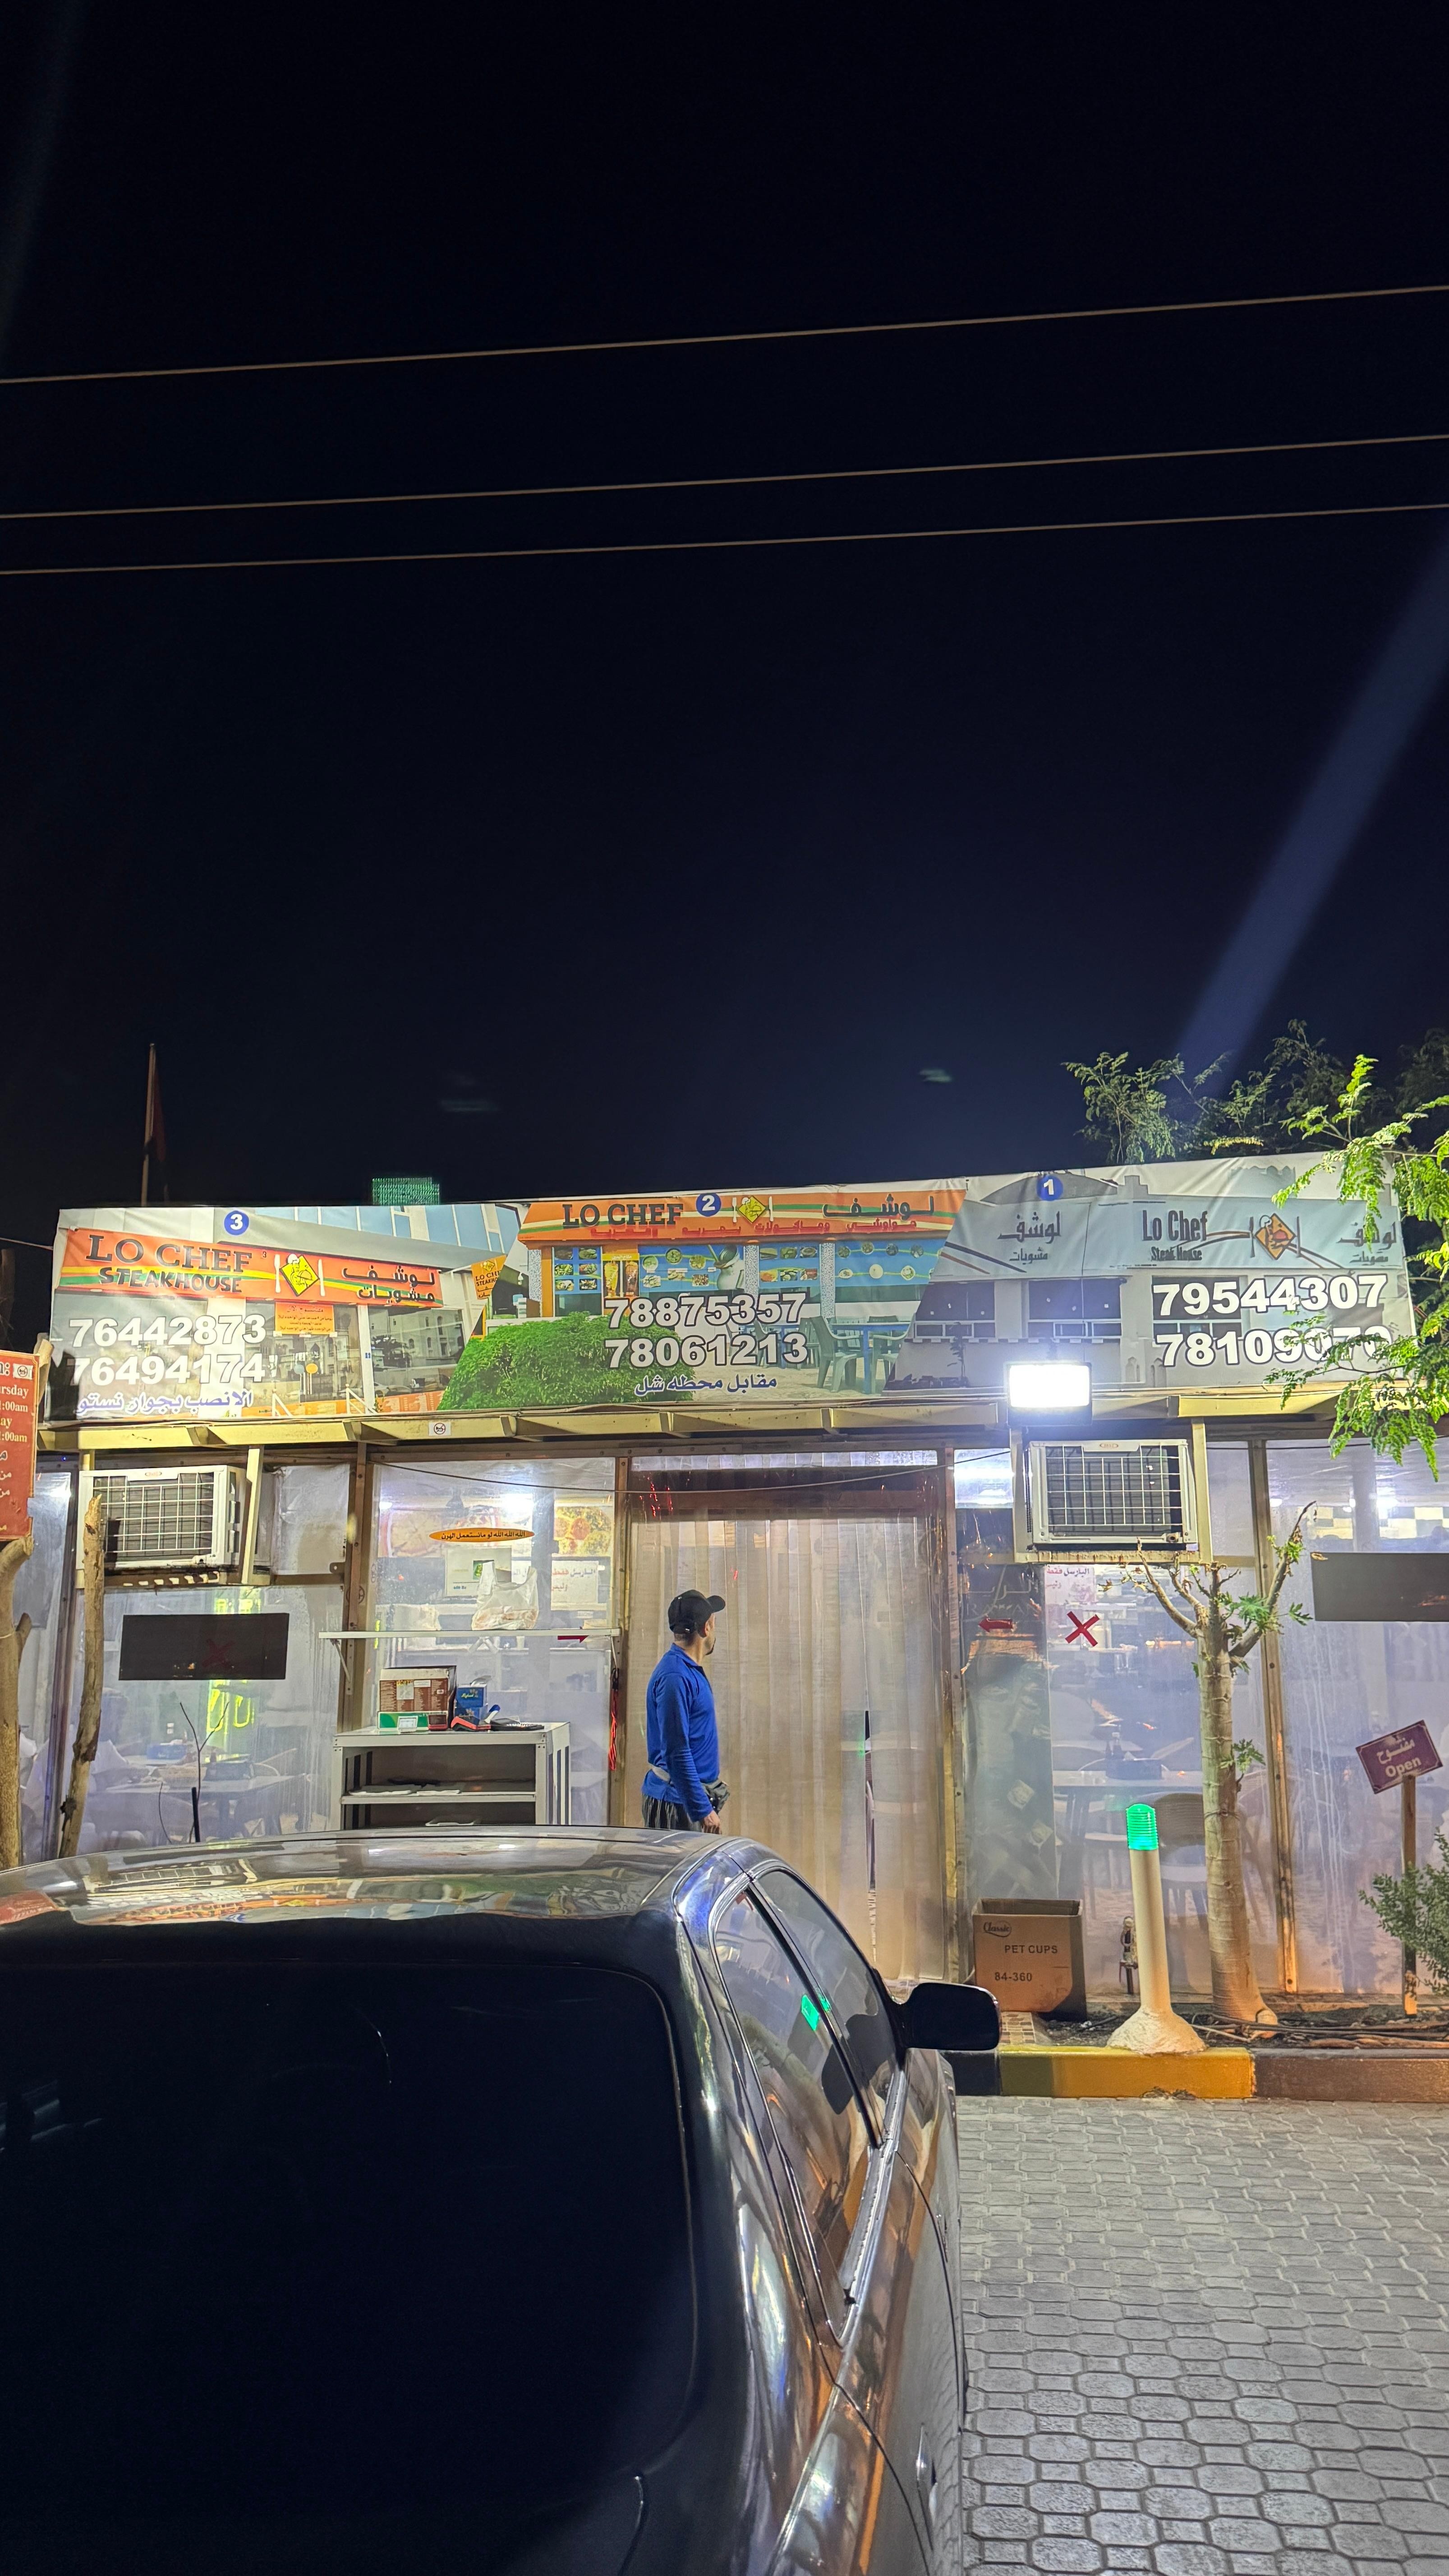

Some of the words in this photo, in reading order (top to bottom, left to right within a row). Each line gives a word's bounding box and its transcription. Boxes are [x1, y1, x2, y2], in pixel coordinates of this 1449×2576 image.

[1044, 1179, 1054, 1195] 1
[702, 1195, 715, 1211] 2
[823, 1193, 934, 1220] لوشف
[230, 1214, 243, 1230] 3
[563, 1204, 600, 1228] LO
[608, 1203, 683, 1225] CHEF
[1142, 1210, 1162, 1241] Lo
[1168, 1210, 1208, 1241] Chef
[997, 1211, 1061, 1244] لوشف
[86, 1234, 144, 1264] LO
[156, 1243, 252, 1273] CHEF
[1009, 1247, 1048, 1265] مشويات
[1150, 1246, 1175, 1261] Steak
[1176, 1245, 1202, 1261] House
[98, 1266, 242, 1293] STEAKHOUSE
[342, 1265, 436, 1287] لوشف
[357, 1284, 436, 1304] مشويات
[1152, 1274, 1388, 1317] 79544307
[603, 1292, 807, 1328] 78875357
[69, 1314, 267, 1348] 76442873
[603, 1332, 808, 1368] 78061213
[72, 1353, 266, 1386] 76494174
[634, 1375, 664, 1397] شل
[667, 1374, 722, 1392] محطه
[727, 1374, 777, 1393] مقابل
[77, 1392, 124, 1415] نستو
[127, 1393, 182, 1414] بجوار
[185, 1390, 253, 1413] الانصب
[1385, 1757, 1421, 1778] Open
[1004, 1945, 1025, 1953] PET
[1028, 1945, 1058, 1953] CUPS
[994, 1972, 1032, 1981] 84-360
